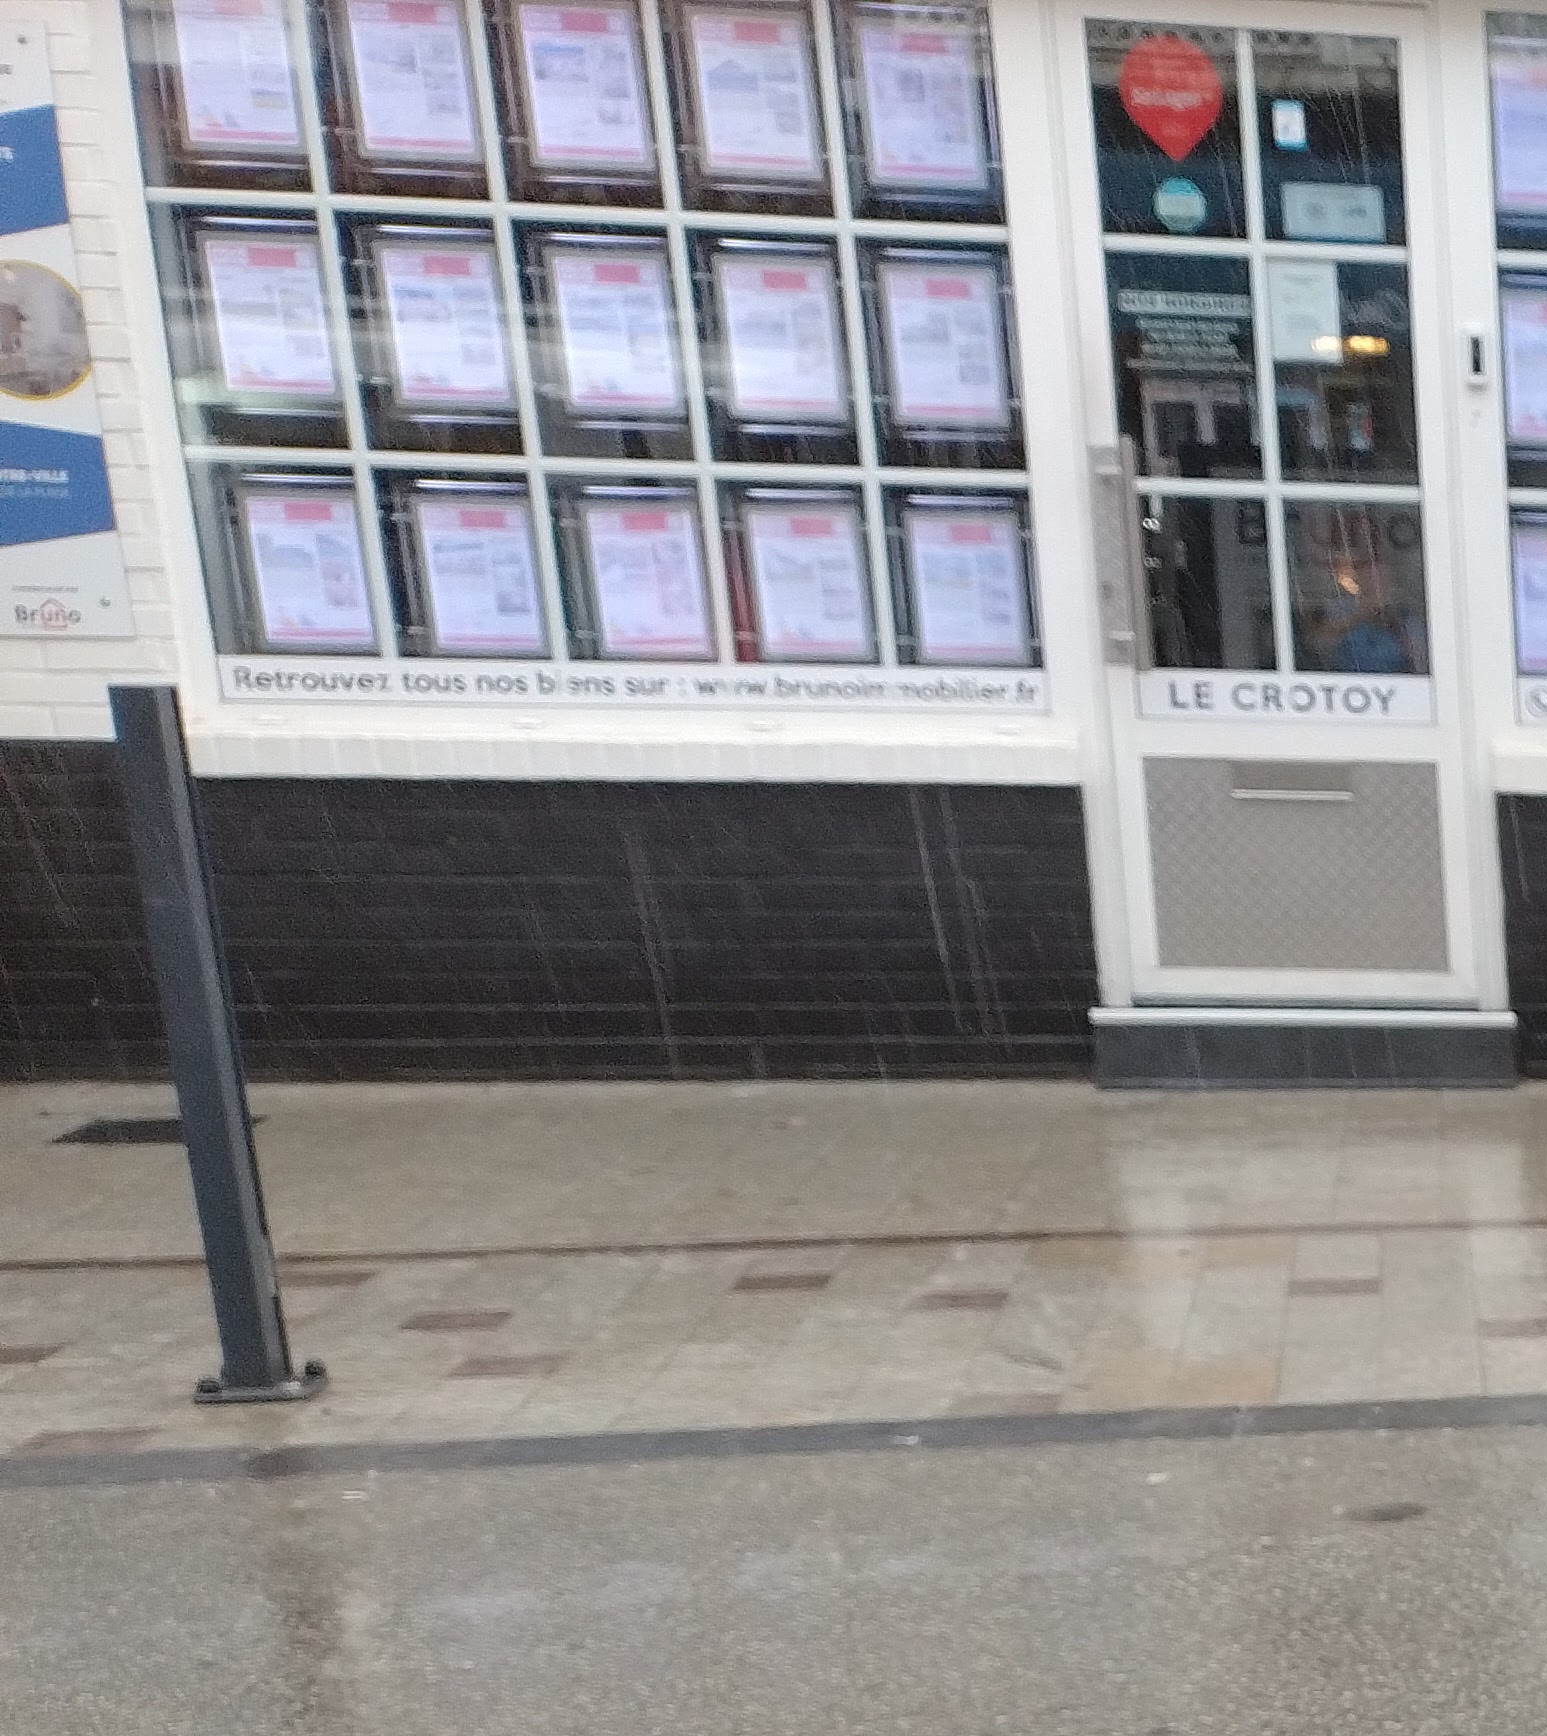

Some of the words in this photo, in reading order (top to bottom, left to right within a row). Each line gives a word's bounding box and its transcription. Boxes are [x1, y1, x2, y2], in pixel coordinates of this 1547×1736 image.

[232, 664, 391, 692] Retrouvez
[401, 671, 468, 694] tous
[475, 673, 529, 694] nos
[536, 668, 617, 696] bens
[624, 676, 668, 696] sur
[1168, 680, 1215, 710] LE
[1231, 680, 1399, 716] CROTOY
